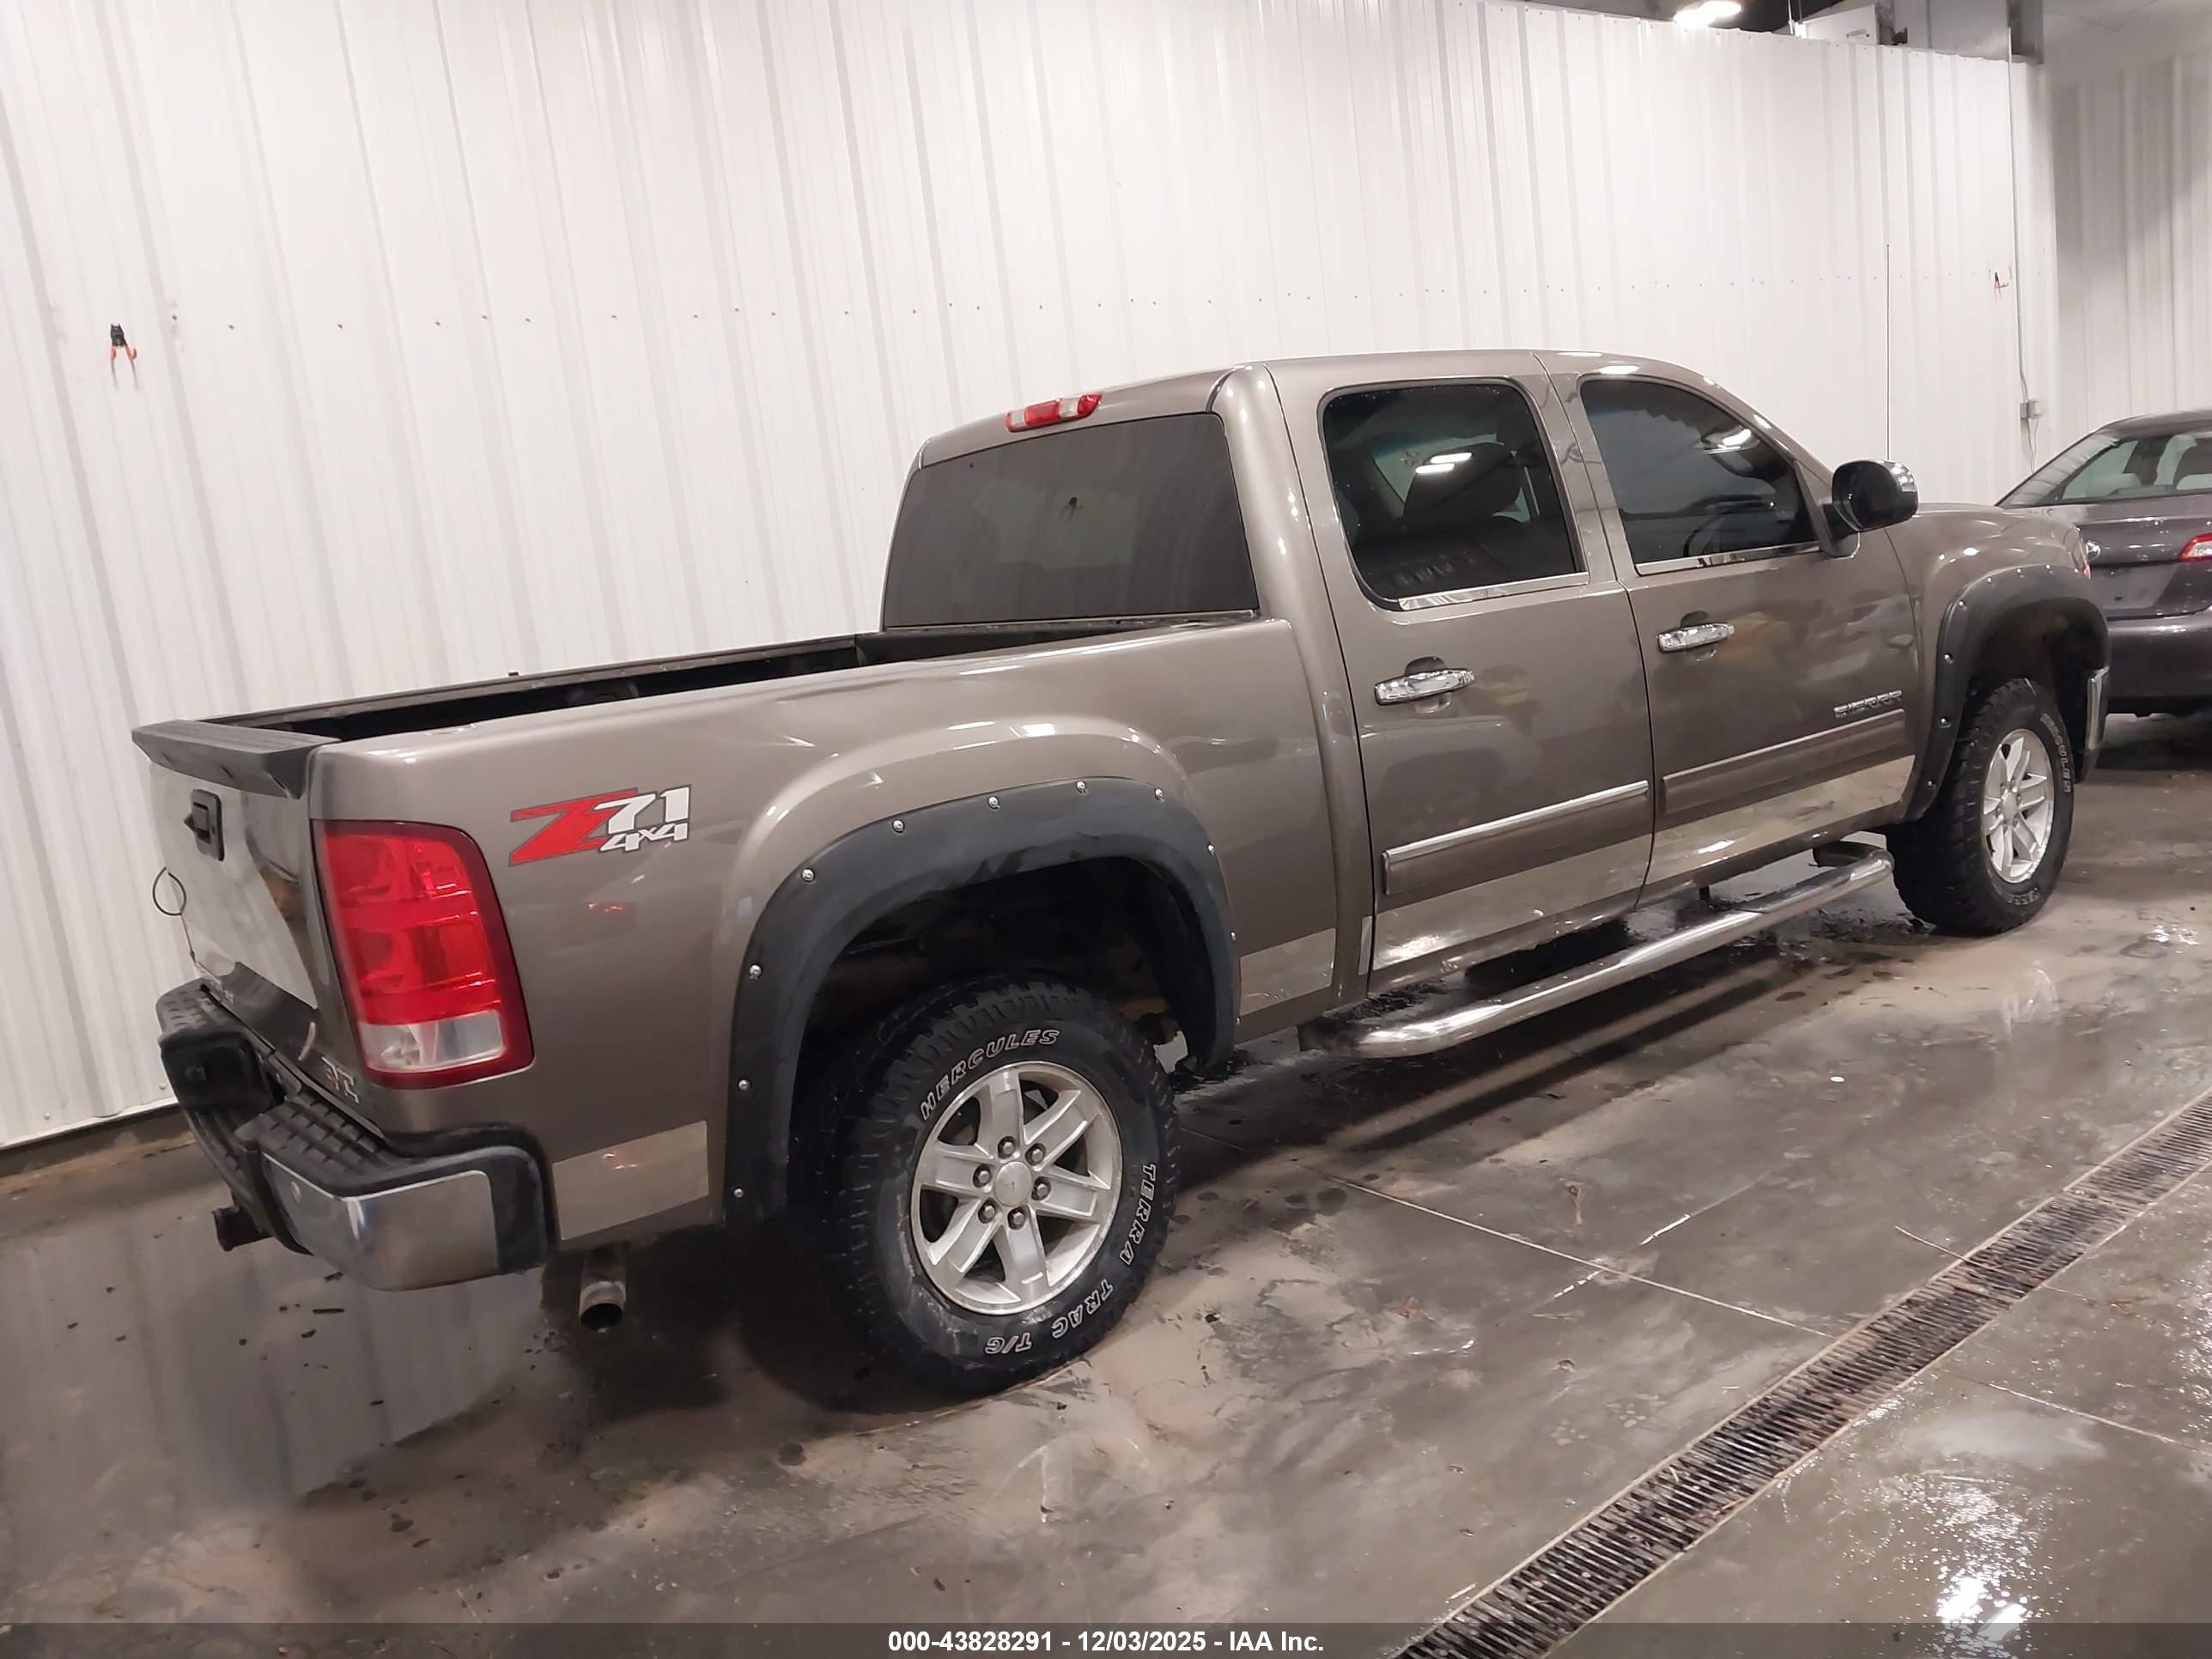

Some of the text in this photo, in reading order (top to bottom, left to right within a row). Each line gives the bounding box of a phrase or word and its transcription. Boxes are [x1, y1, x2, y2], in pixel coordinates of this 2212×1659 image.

[509, 785, 690, 866] Z71
[921, 1030, 1060, 1120] HERCULES
[985, 1164, 1156, 1353] TERRA TRAC T/G
